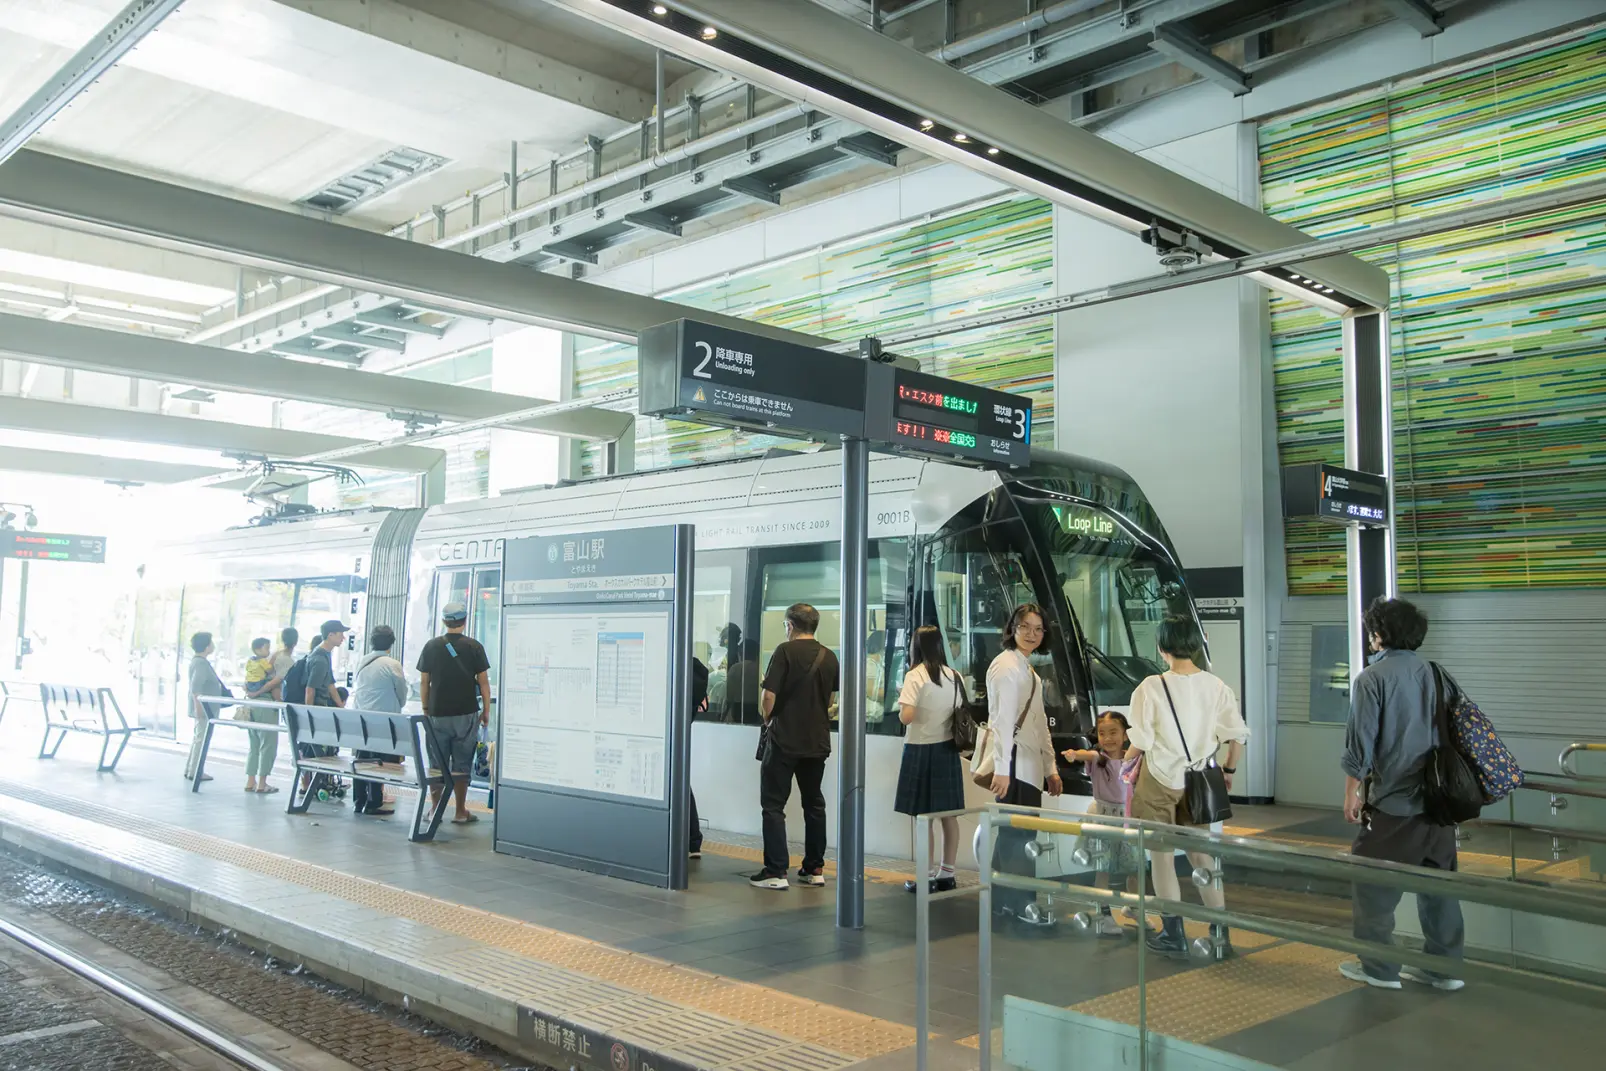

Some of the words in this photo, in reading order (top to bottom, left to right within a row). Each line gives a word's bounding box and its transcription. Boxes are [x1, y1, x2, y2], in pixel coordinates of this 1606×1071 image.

[693, 341, 712, 379] 2
[715, 347, 753, 366] 降車専用
[715, 360, 743, 375] Unloading
[743, 367, 756, 377] only
[714, 388, 794, 412] ここからは乗車できません
[731, 402, 745, 410] board
[745, 404, 758, 412] trains
[763, 407, 772, 415] this
[772, 408, 791, 418] platform
[1012, 408, 1026, 439] 3
[990, 439, 1010, 450] おしらせ
[1324, 475, 1332, 497] 4
[877, 510, 910, 525] 9001B
[1068, 513, 1091, 534] Loop
[1093, 516, 1113, 534] Line
[701, 528, 723, 538] LIGHT
[726, 526, 743, 535] RAIL
[746, 524, 778, 534] TRANSIT
[782, 521, 805, 531] SINCE
[810, 519, 830, 530] 2009
[93, 540, 103, 553] 3
[562, 538, 605, 562] 富山駅
[567, 580, 588, 591] Toyama
[588, 579, 599, 589] Sta.
[533, 1016, 592, 1059] 横断禁止
